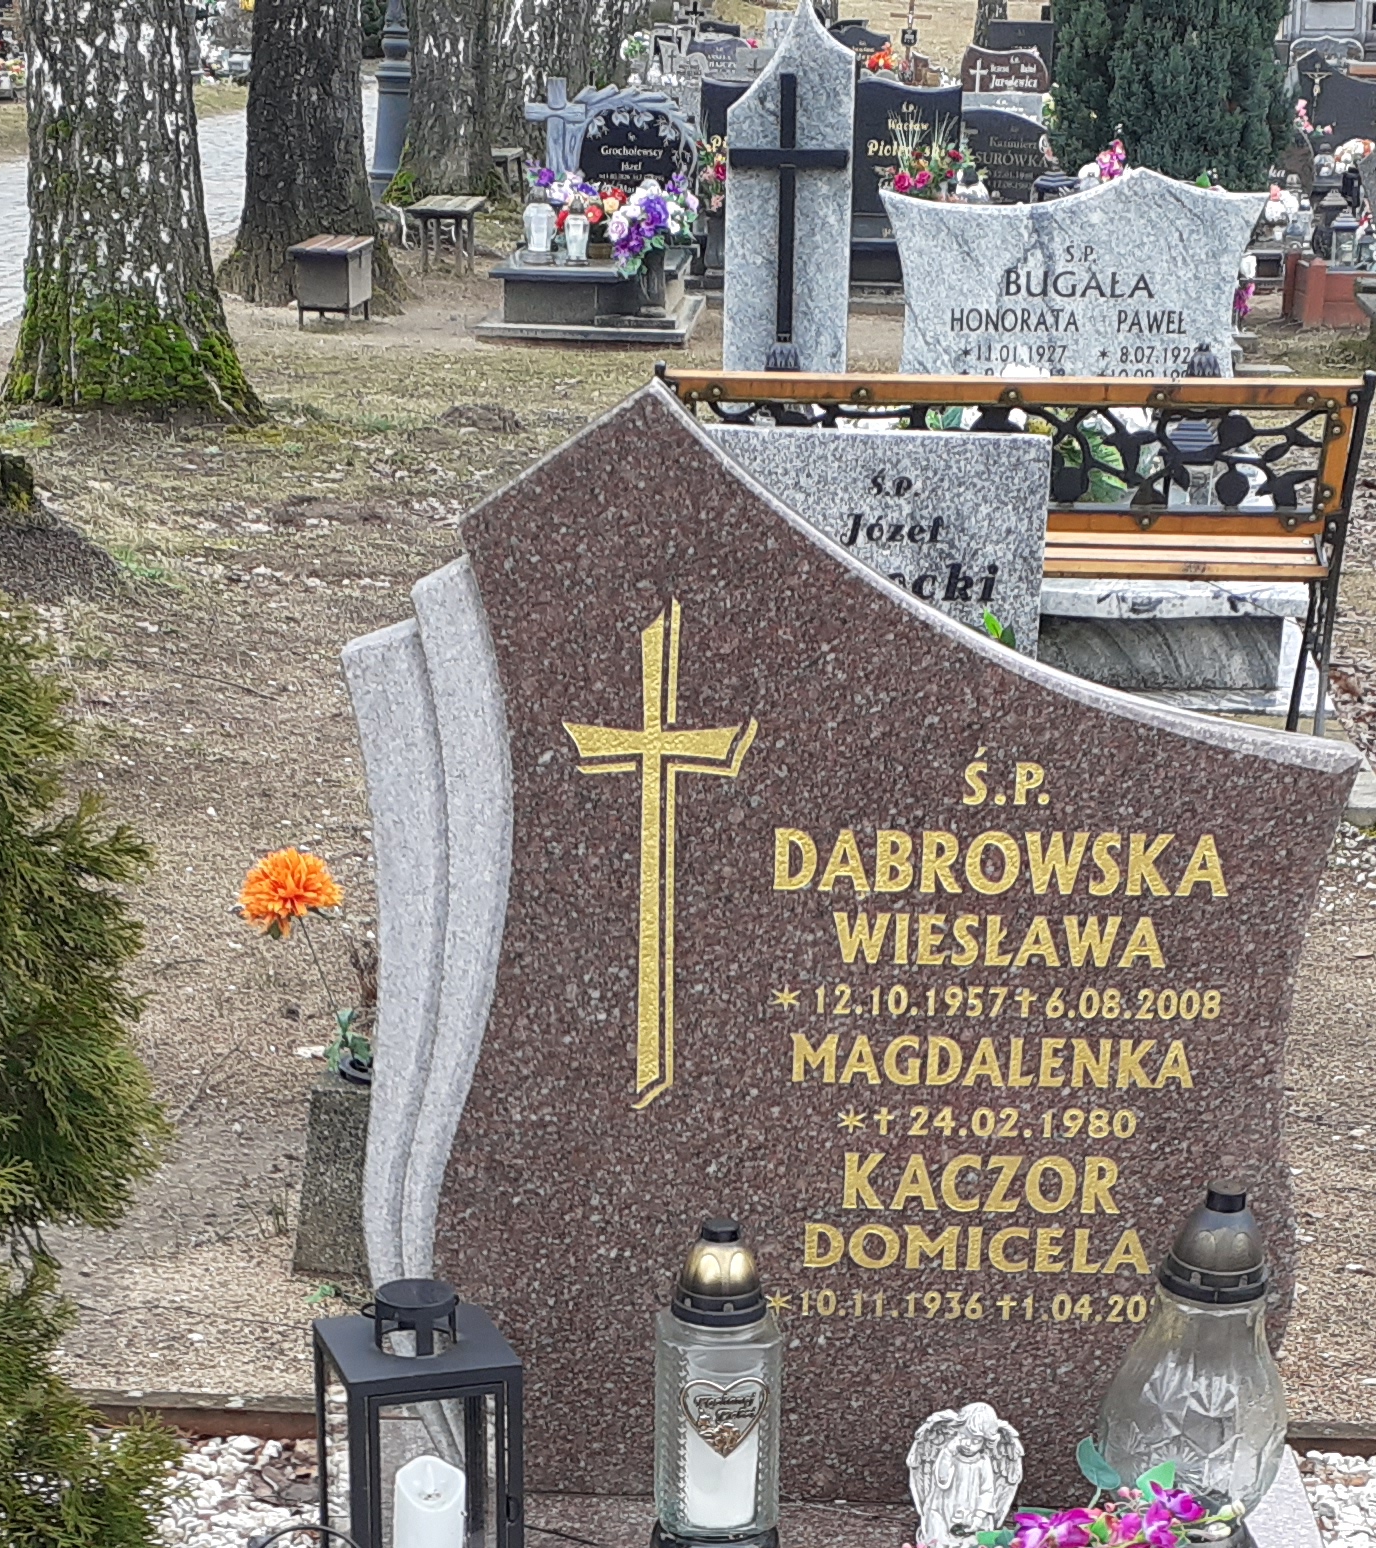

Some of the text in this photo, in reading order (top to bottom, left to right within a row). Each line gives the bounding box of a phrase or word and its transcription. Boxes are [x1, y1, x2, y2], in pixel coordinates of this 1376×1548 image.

[976, 150, 1049, 168] SURÓWKA
[1004, 270, 1155, 299] BUGAŁA
[950, 308, 1186, 334] HONORATA PAWEŁ
[839, 513, 944, 547] Józef
[963, 747, 1050, 806] Ś.P.
[772, 827, 1229, 899] DĄBROWSKA
[832, 911, 1166, 969] WIESŁAWA
[790, 1032, 1194, 1089] MAGDALENKA
[907, 1106, 1138, 1139] 24.02.1980
[842, 1151, 1121, 1215] KACZOR
[802, 1222, 1152, 1275] DOMICELA
[1023, 1292, 1158, 1324] 1.04.20
